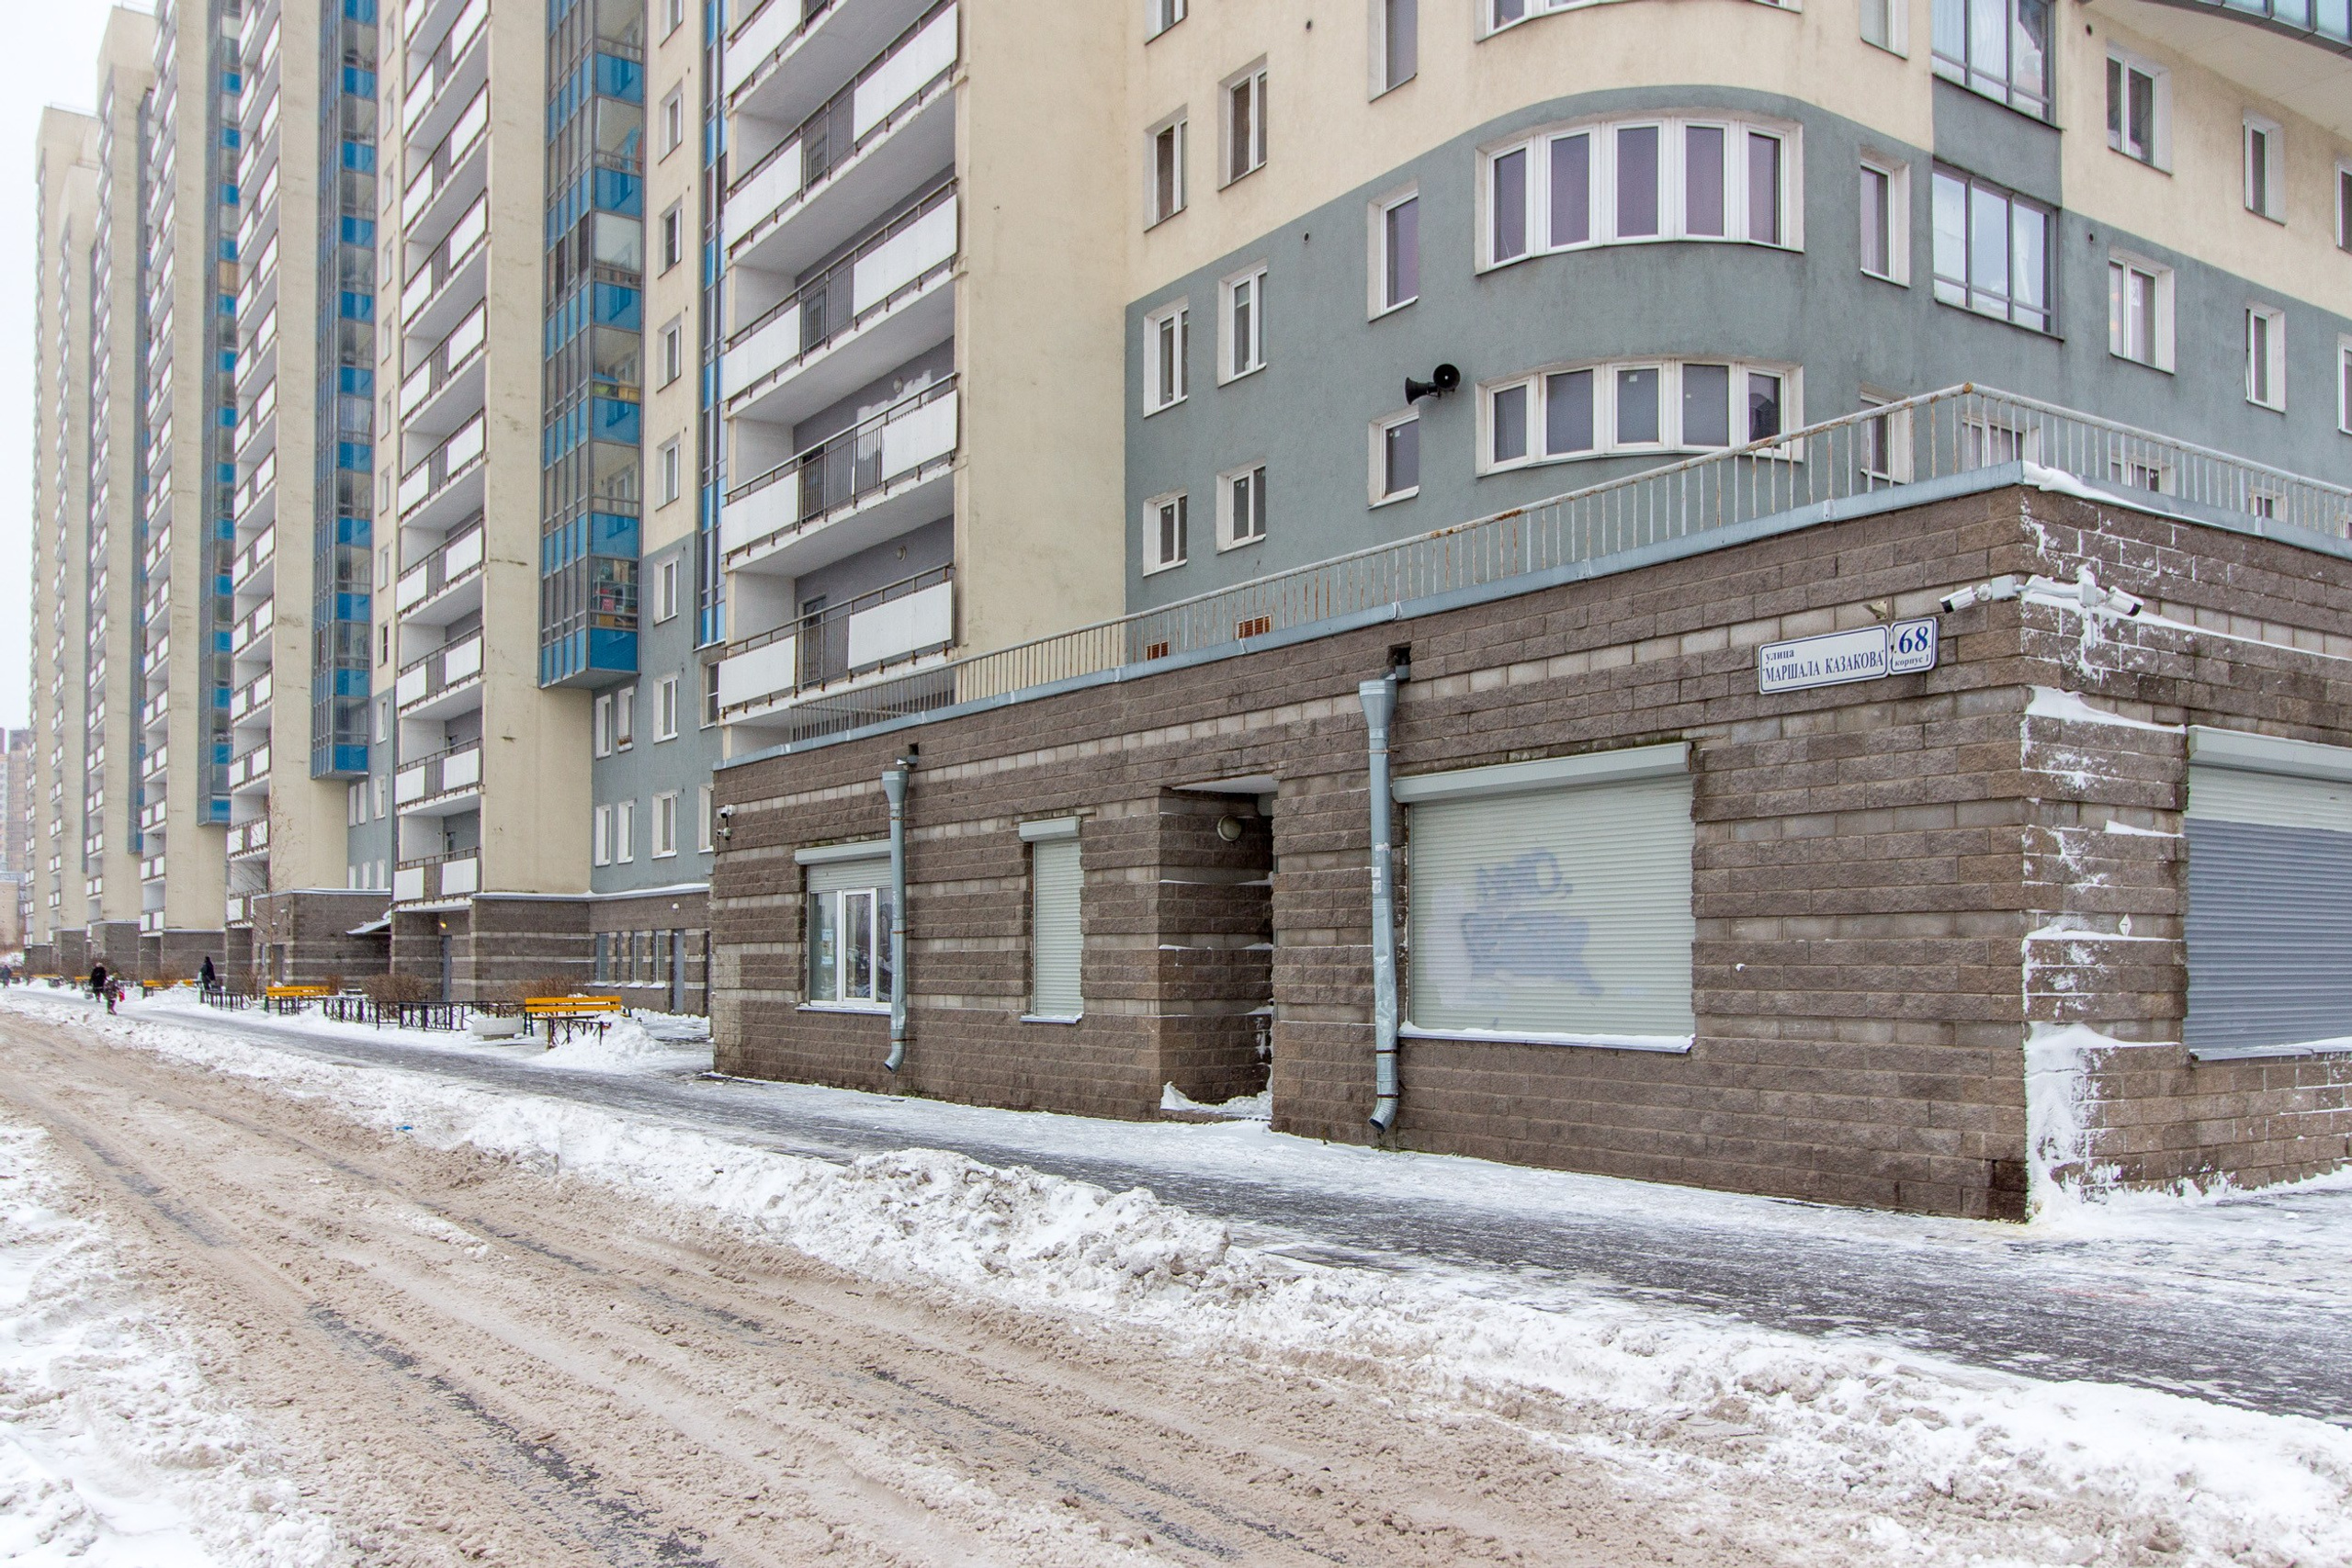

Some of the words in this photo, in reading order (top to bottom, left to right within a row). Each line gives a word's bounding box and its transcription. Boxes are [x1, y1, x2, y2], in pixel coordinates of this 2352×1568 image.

[1898, 626, 1929, 655] 68
[1765, 649, 1794, 664] улица
[1765, 660, 1820, 682] МАРШАЛА
[1826, 650, 1883, 674] КАЗАКОВА
[1894, 656, 1923, 668] корпус
